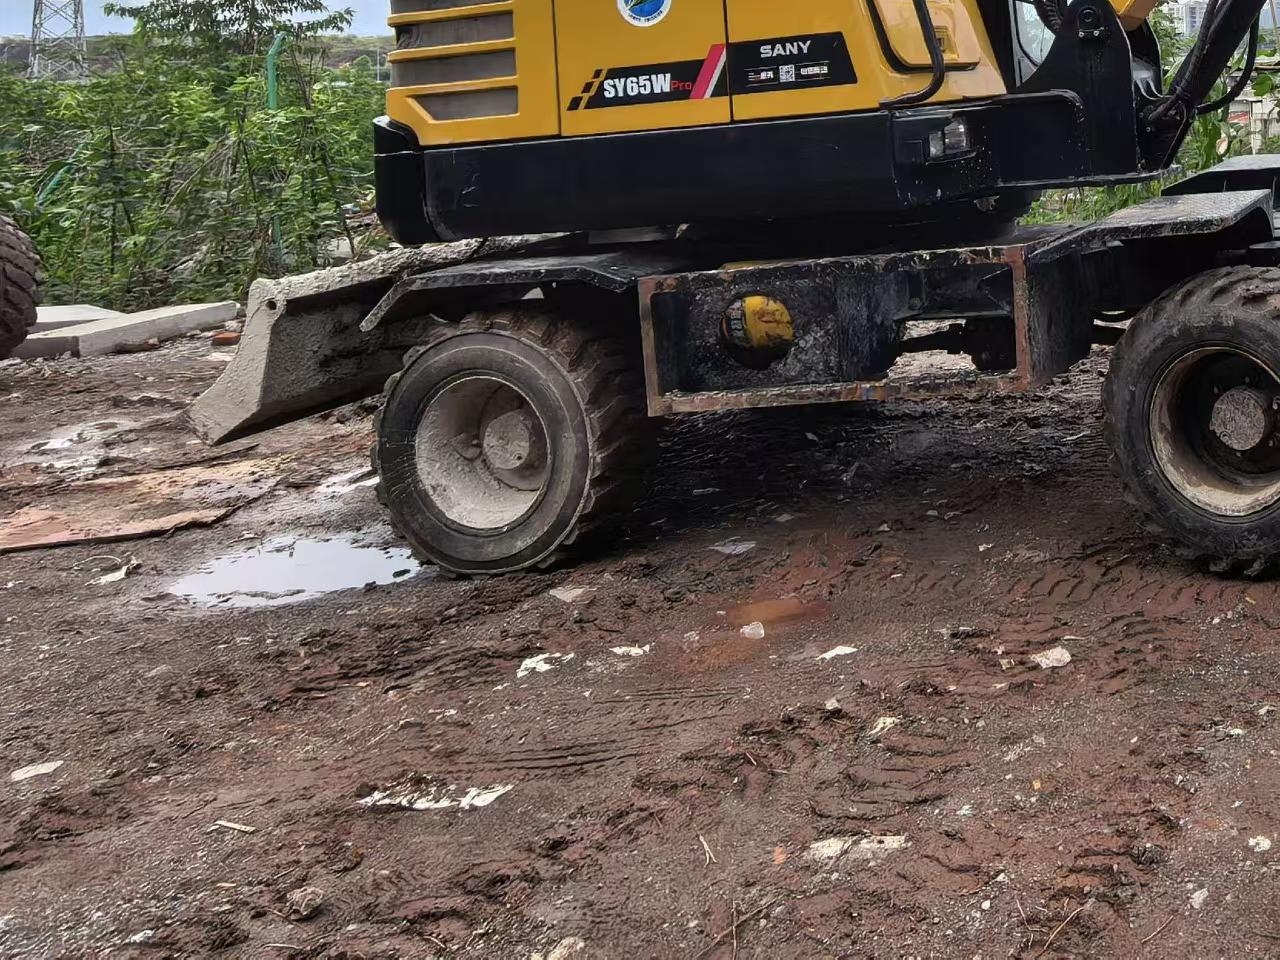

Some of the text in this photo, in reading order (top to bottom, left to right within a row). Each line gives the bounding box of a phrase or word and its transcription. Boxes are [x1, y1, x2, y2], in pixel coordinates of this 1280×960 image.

[760, 40, 811, 58] SANY
[603, 72, 692, 98] SY65W Pro
